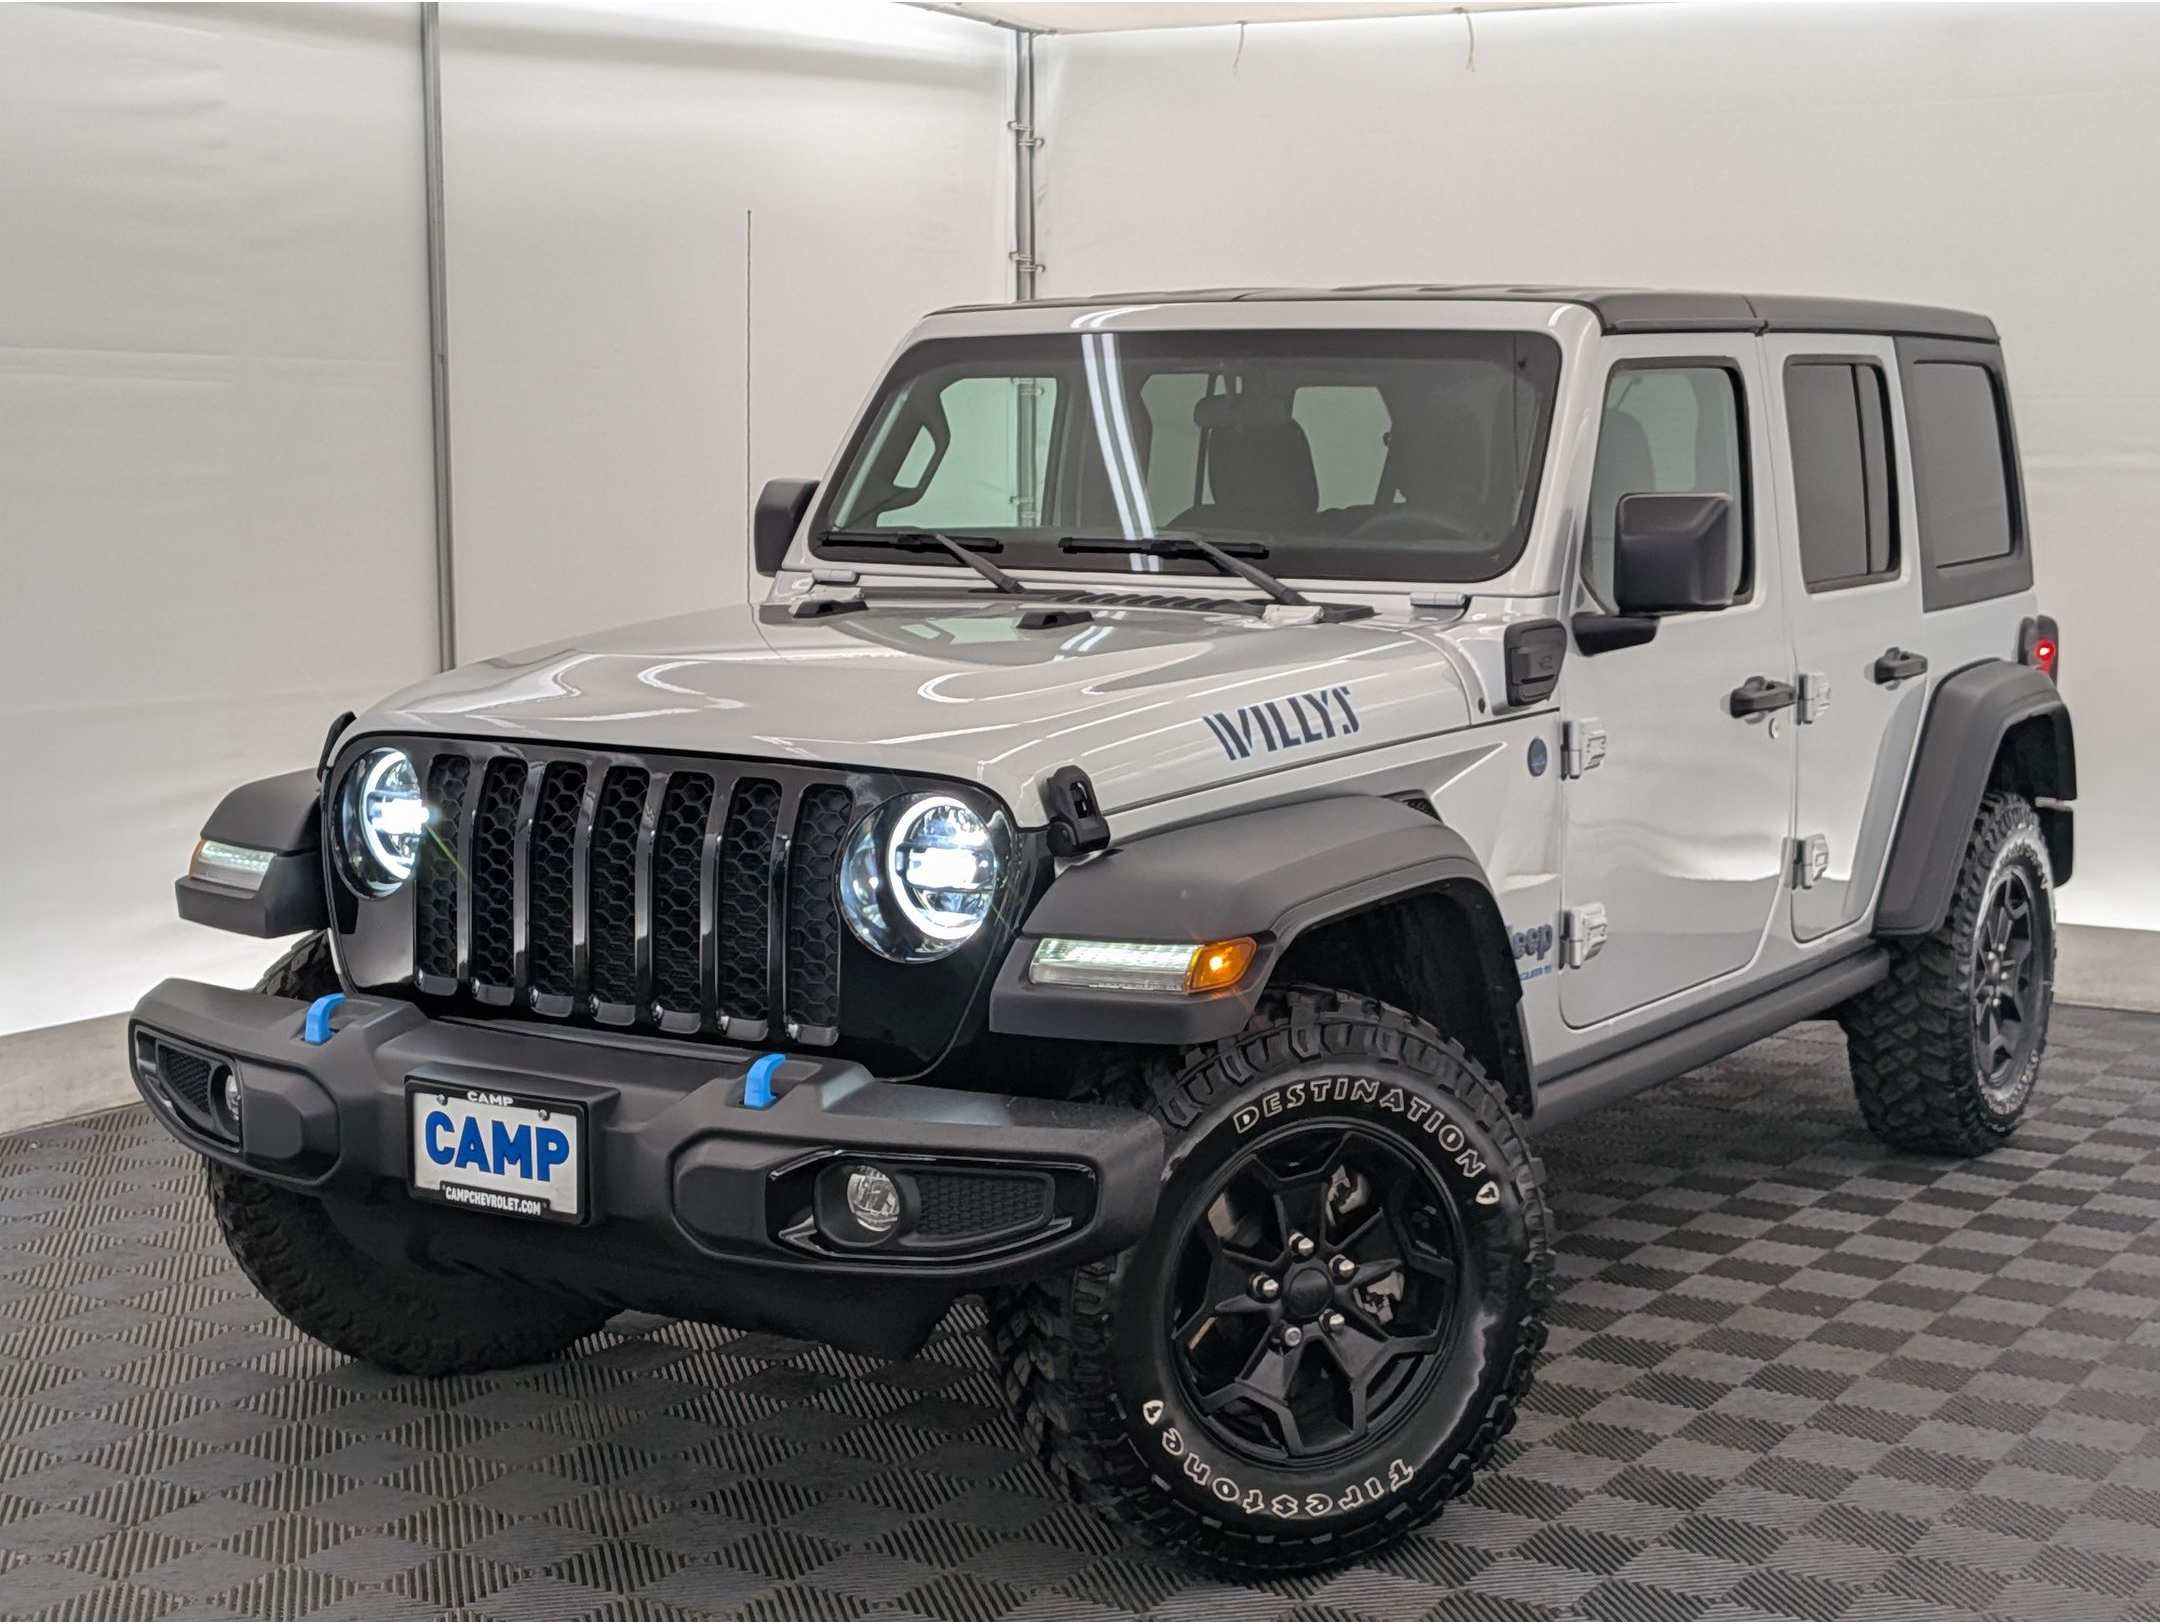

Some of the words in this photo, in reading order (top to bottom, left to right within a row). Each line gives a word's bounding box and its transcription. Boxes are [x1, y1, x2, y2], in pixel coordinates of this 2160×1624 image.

[1202, 686, 1360, 760] WILLYS
[1504, 924, 1553, 961] eep
[467, 1091, 514, 1106] CAMP
[425, 1110, 570, 1182] CAMP
[1233, 1078, 1486, 1178] DESTINATION
[445, 1186, 541, 1216] CAMPCHEVROLET.COM
